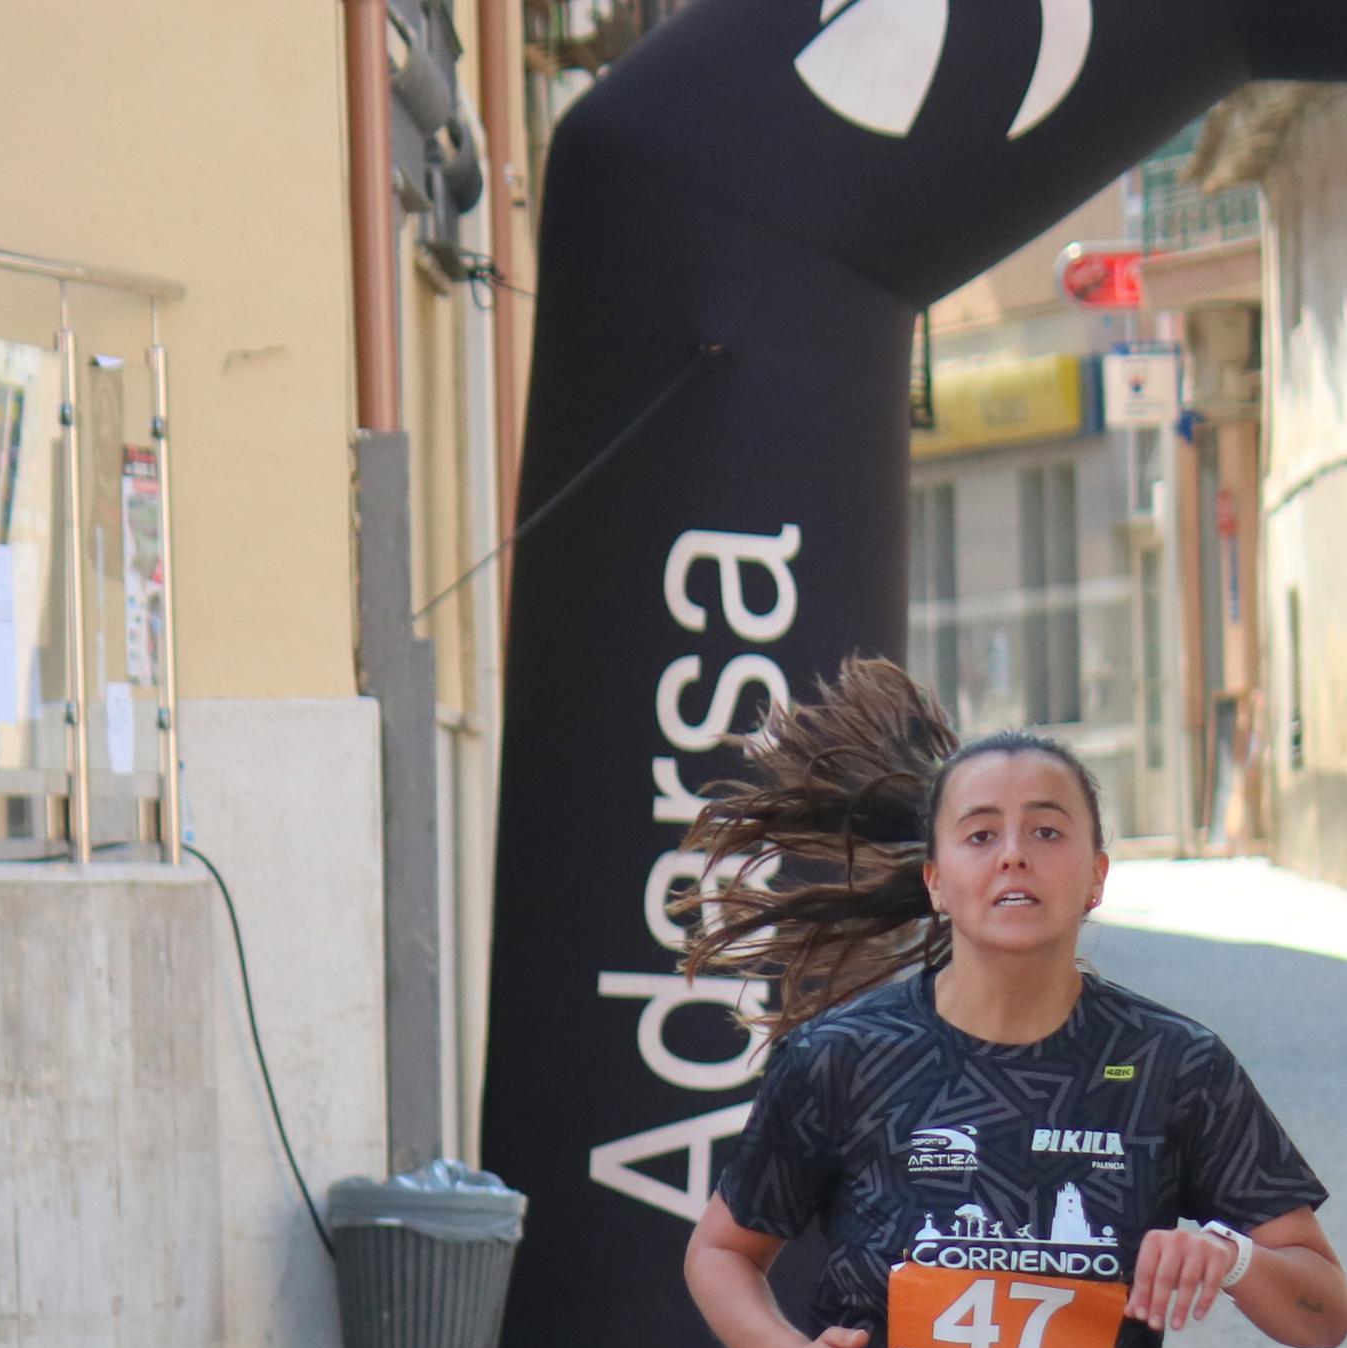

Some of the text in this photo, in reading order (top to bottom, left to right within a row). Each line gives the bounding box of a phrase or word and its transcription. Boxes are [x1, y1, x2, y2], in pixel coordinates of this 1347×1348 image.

[1031, 1128, 1125, 1156] BIKILA
[906, 1152, 979, 1166] ARTIZA
[1092, 1160, 1126, 1170] PALENCIA
[911, 1241, 1120, 1276] CORRIENDO
